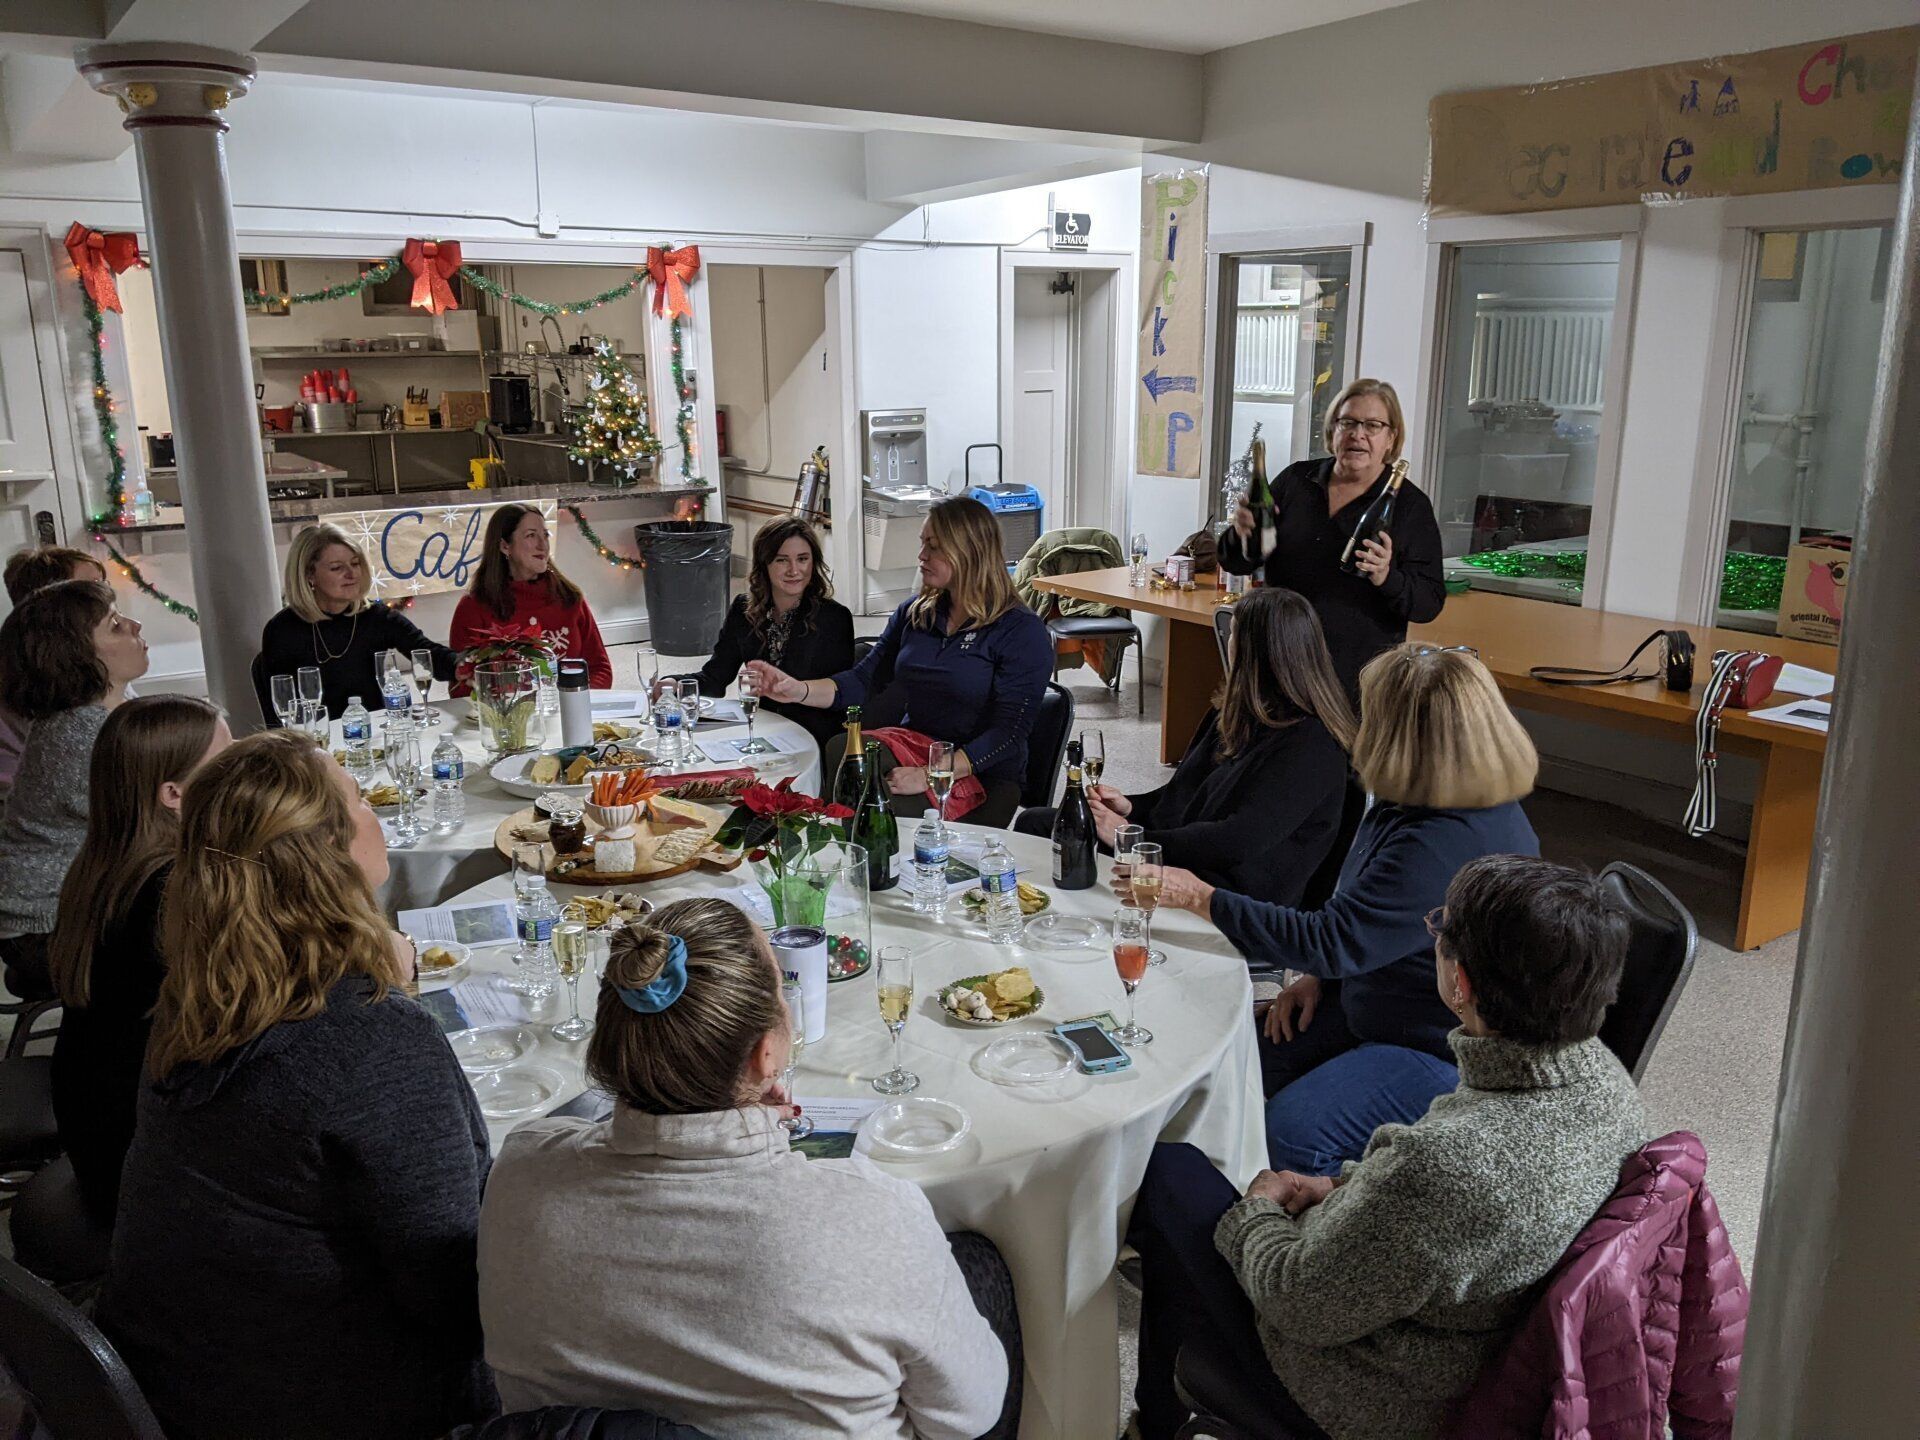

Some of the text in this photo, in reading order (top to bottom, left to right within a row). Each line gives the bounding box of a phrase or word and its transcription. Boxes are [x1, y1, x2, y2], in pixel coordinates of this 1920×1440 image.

[1055, 234, 1089, 245] ELEVATOR
[1154, 178, 1198, 356] Pick
[381, 507, 483, 587] Caf
